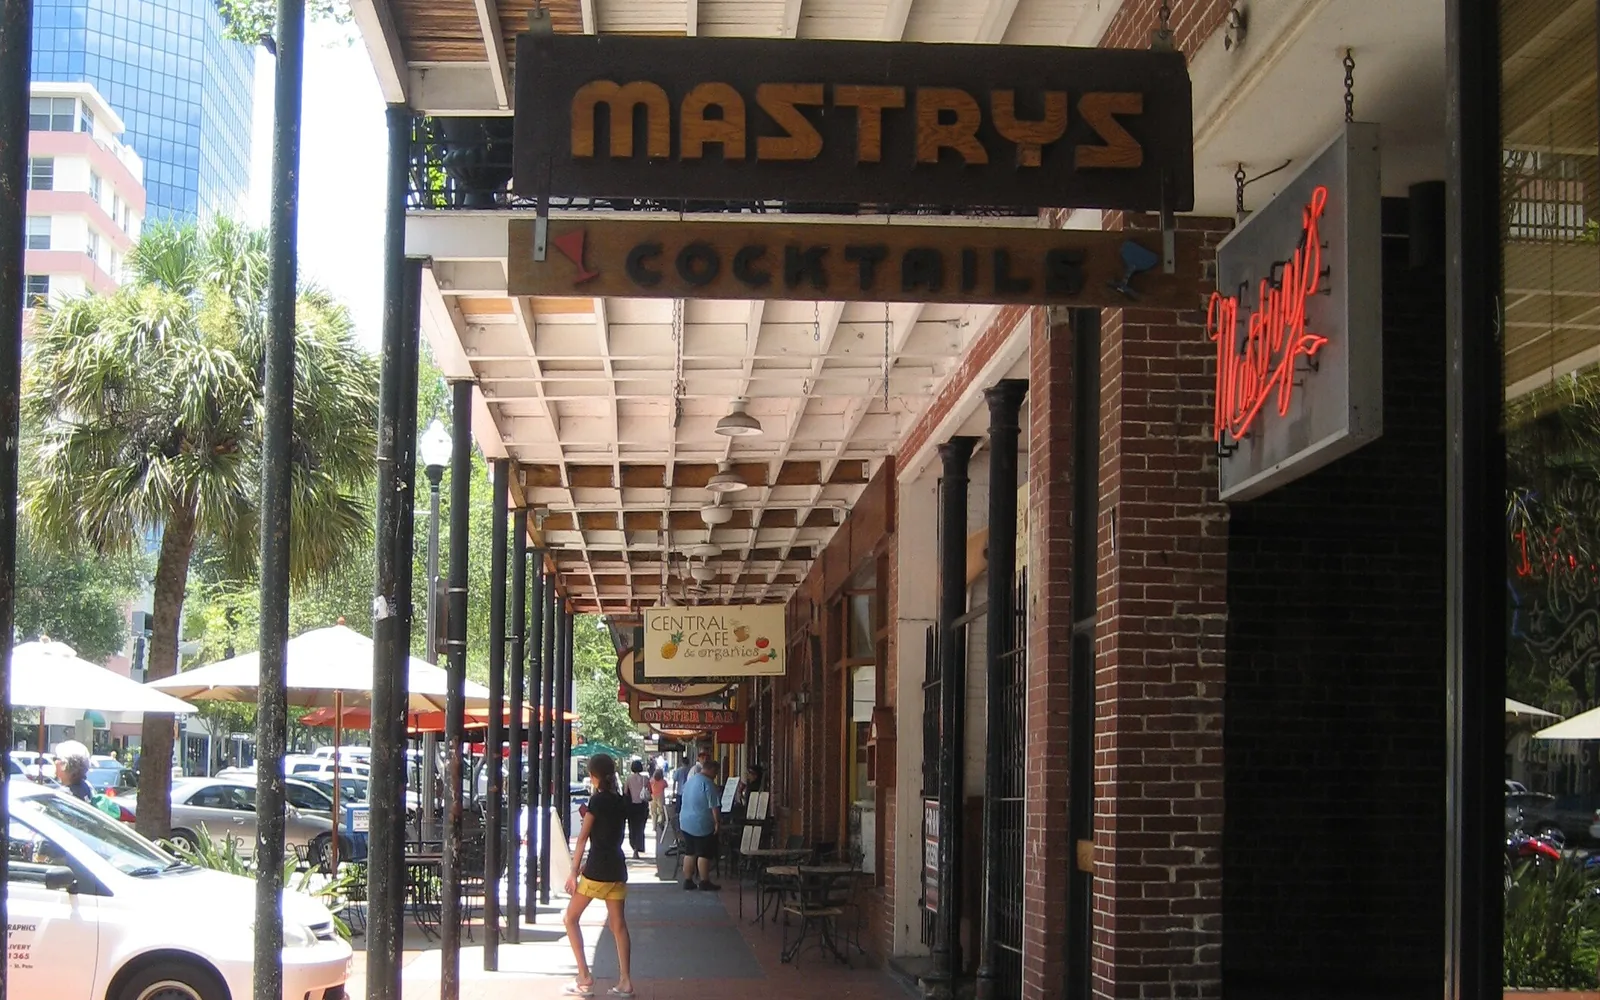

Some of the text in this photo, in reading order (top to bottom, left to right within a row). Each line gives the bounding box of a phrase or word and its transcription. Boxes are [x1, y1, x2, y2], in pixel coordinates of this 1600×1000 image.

[570, 79, 1144, 170] MASTRYS
[625, 241, 1087, 293] COCKTAILS
[651, 615, 729, 631] CENTRAL
[688, 631, 729, 647] CAFE
[684, 645, 760, 661] & organics
[644, 709, 734, 723] OYSTER BAR
